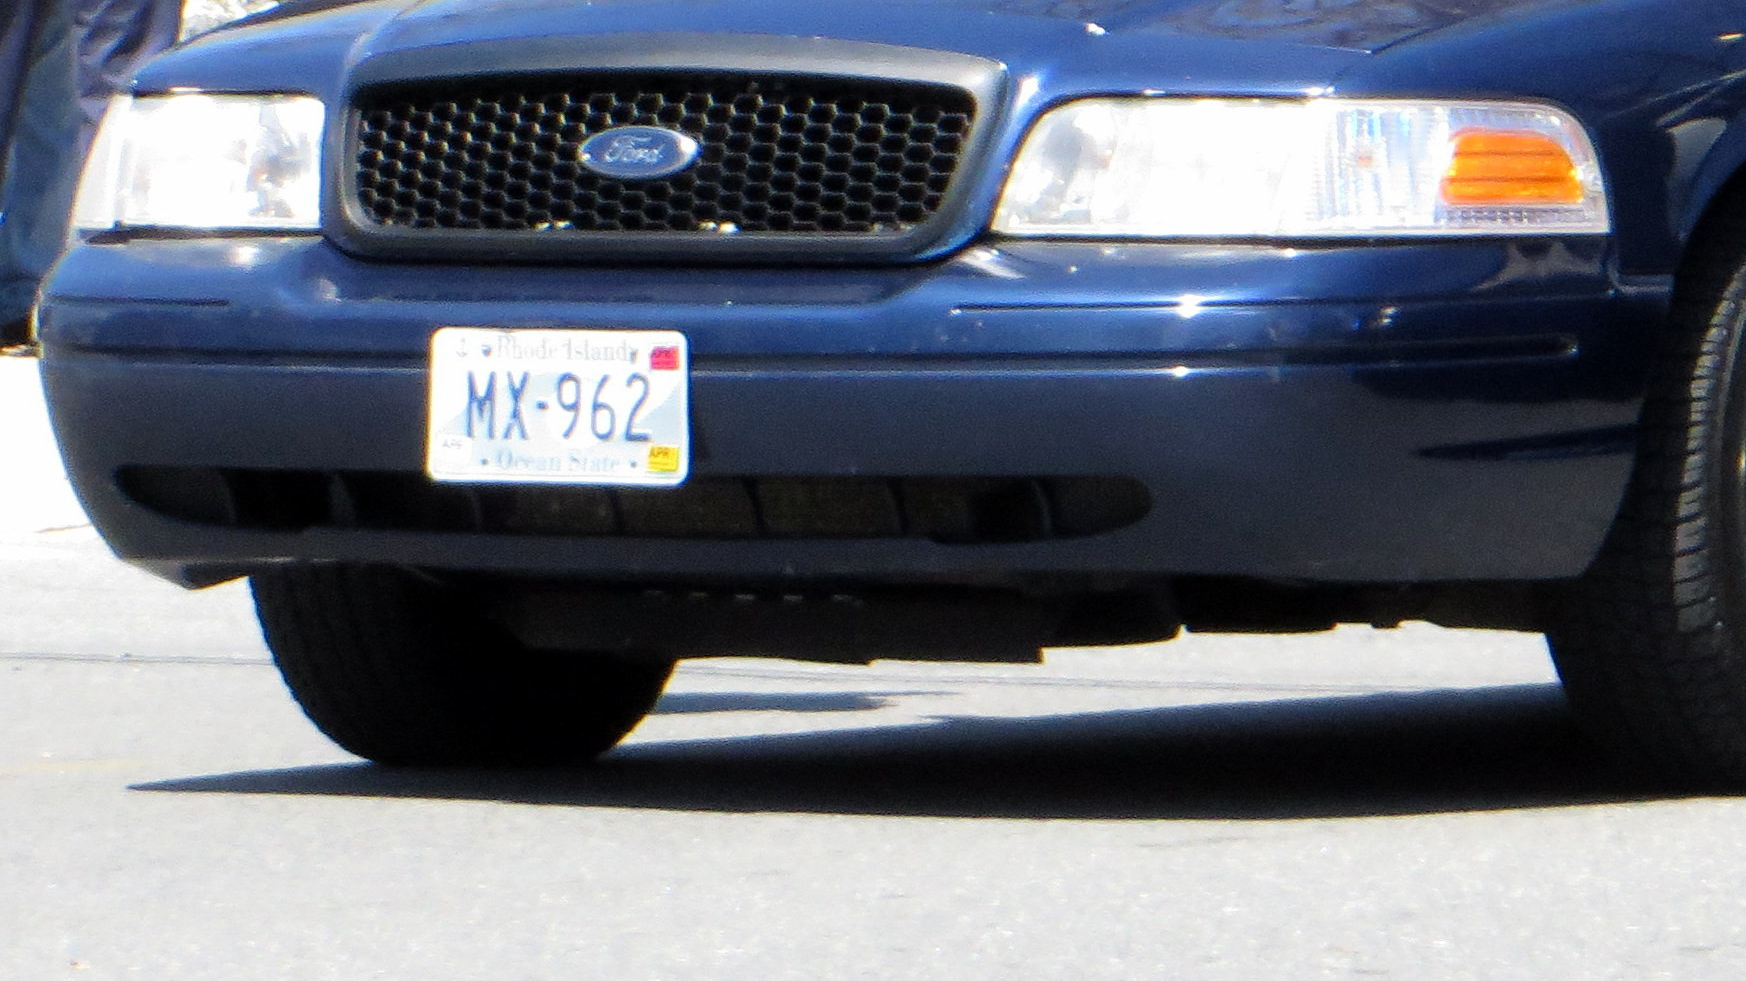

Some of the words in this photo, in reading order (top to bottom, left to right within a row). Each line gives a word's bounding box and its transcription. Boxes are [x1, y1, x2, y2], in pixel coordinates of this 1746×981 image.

[497, 334, 558, 360] Rhode
[561, 337, 630, 362] Island
[466, 370, 651, 443] MX-962
